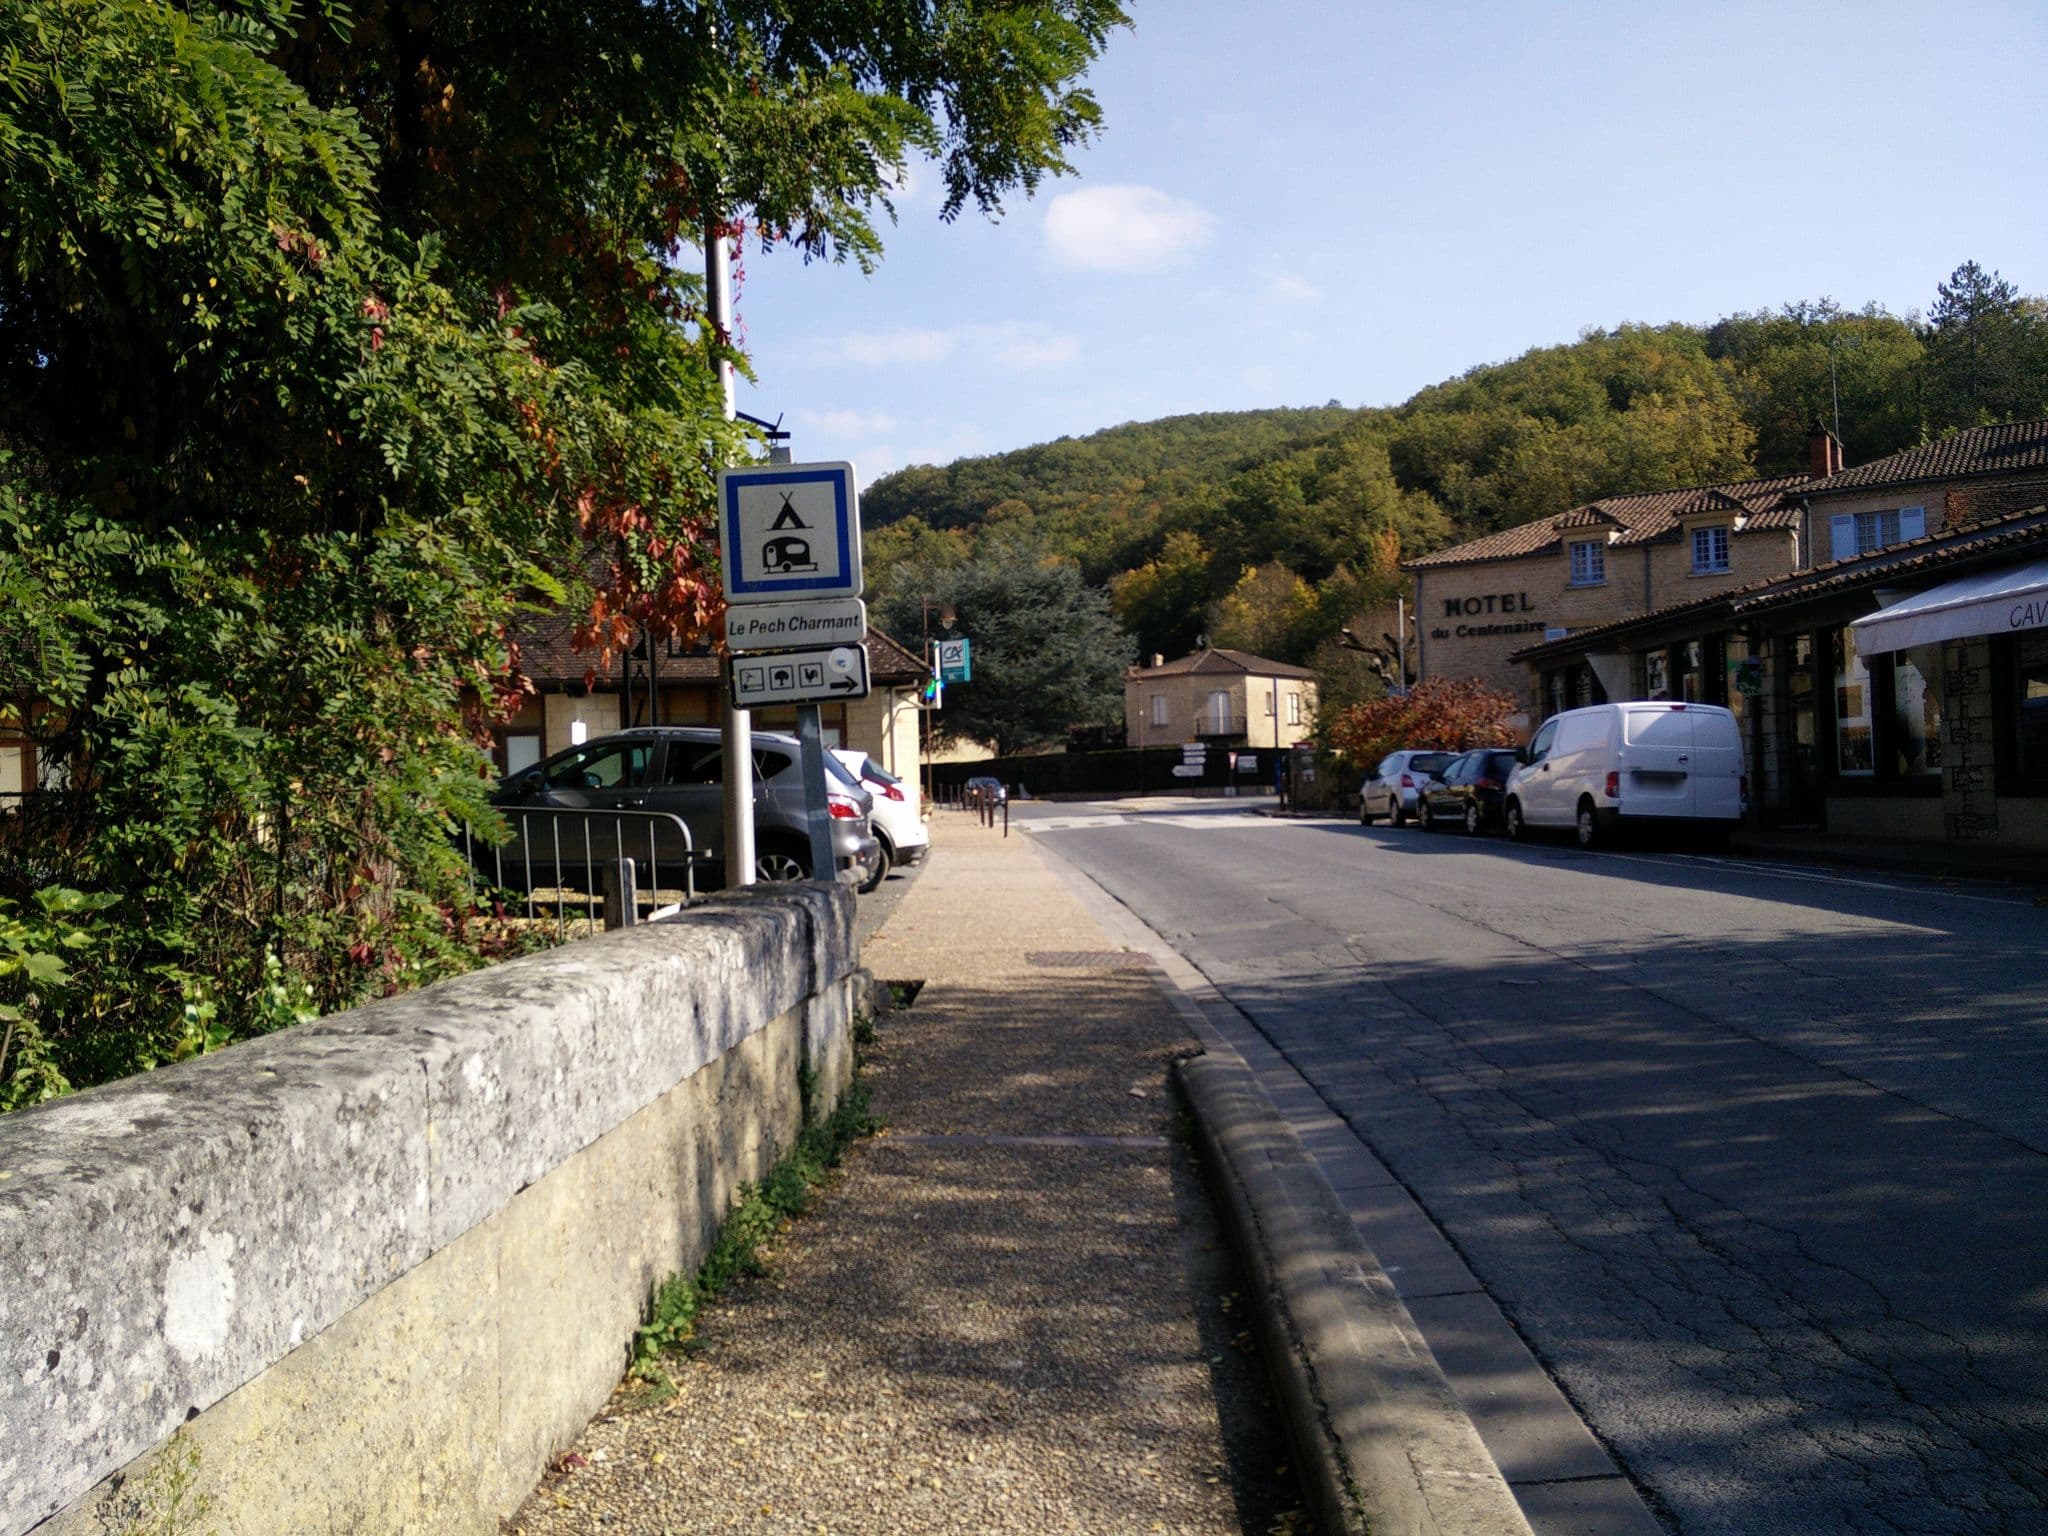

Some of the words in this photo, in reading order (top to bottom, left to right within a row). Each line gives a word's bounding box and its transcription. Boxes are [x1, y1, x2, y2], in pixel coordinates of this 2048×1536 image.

[1444, 592, 1536, 617] HOTEL
[729, 621, 745, 636] Le
[749, 618, 786, 635] Pech
[788, 615, 859, 631] Charmant
[1431, 627, 1450, 639] du
[1456, 620, 1546, 638] Centenaire
